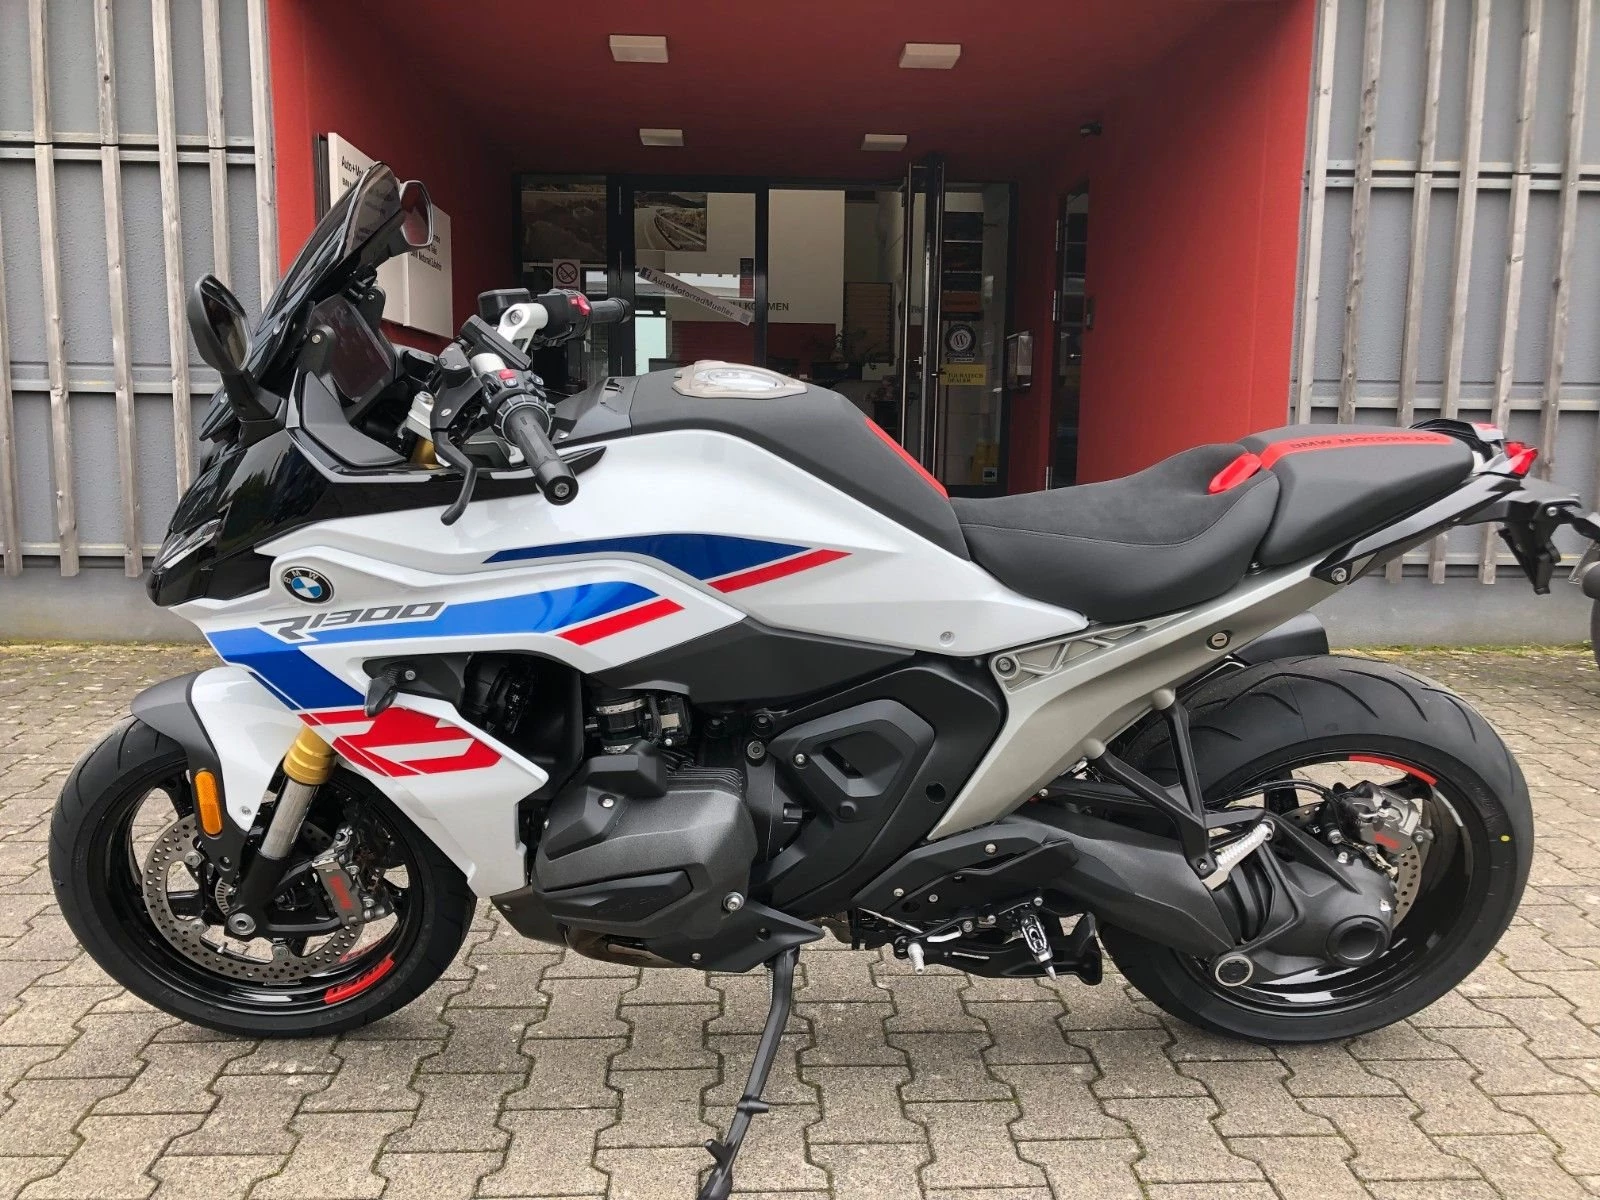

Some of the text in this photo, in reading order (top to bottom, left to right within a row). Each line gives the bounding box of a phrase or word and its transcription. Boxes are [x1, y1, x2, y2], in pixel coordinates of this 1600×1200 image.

[1290, 435, 1438, 449] BMW MOTORRAD
[283, 570, 319, 585] BMW
